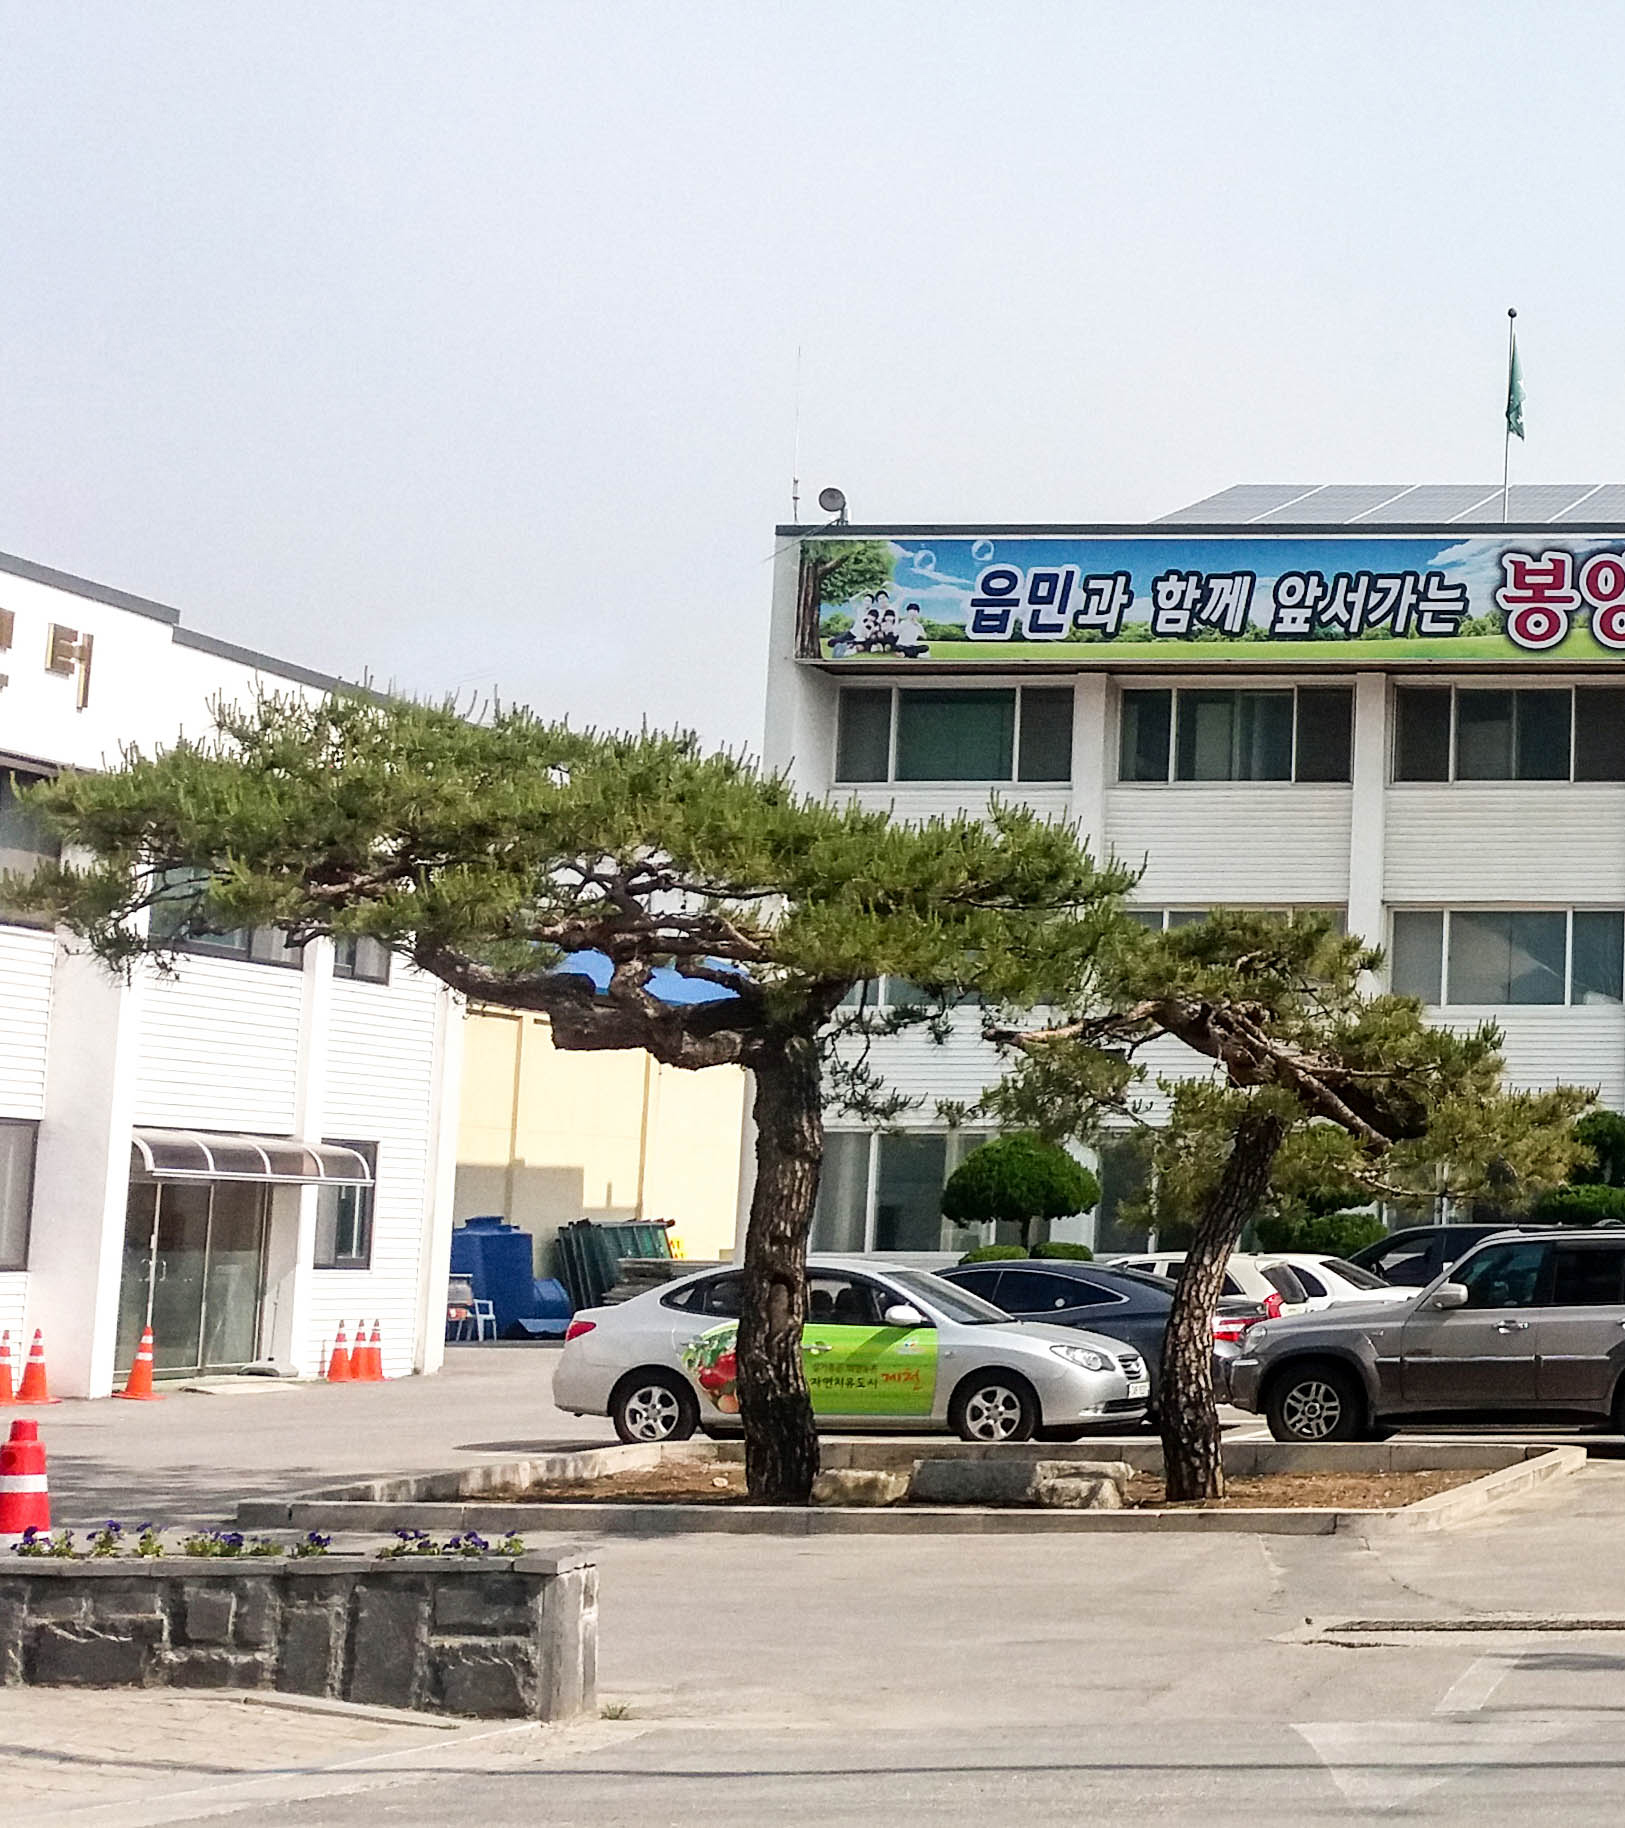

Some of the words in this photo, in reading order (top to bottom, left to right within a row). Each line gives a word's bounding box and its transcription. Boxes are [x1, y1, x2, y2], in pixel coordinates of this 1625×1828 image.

[968, 565, 1133, 637] 읍민과
[1153, 570, 1255, 637] 함께
[1272, 570, 1468, 637] 앞서가는
